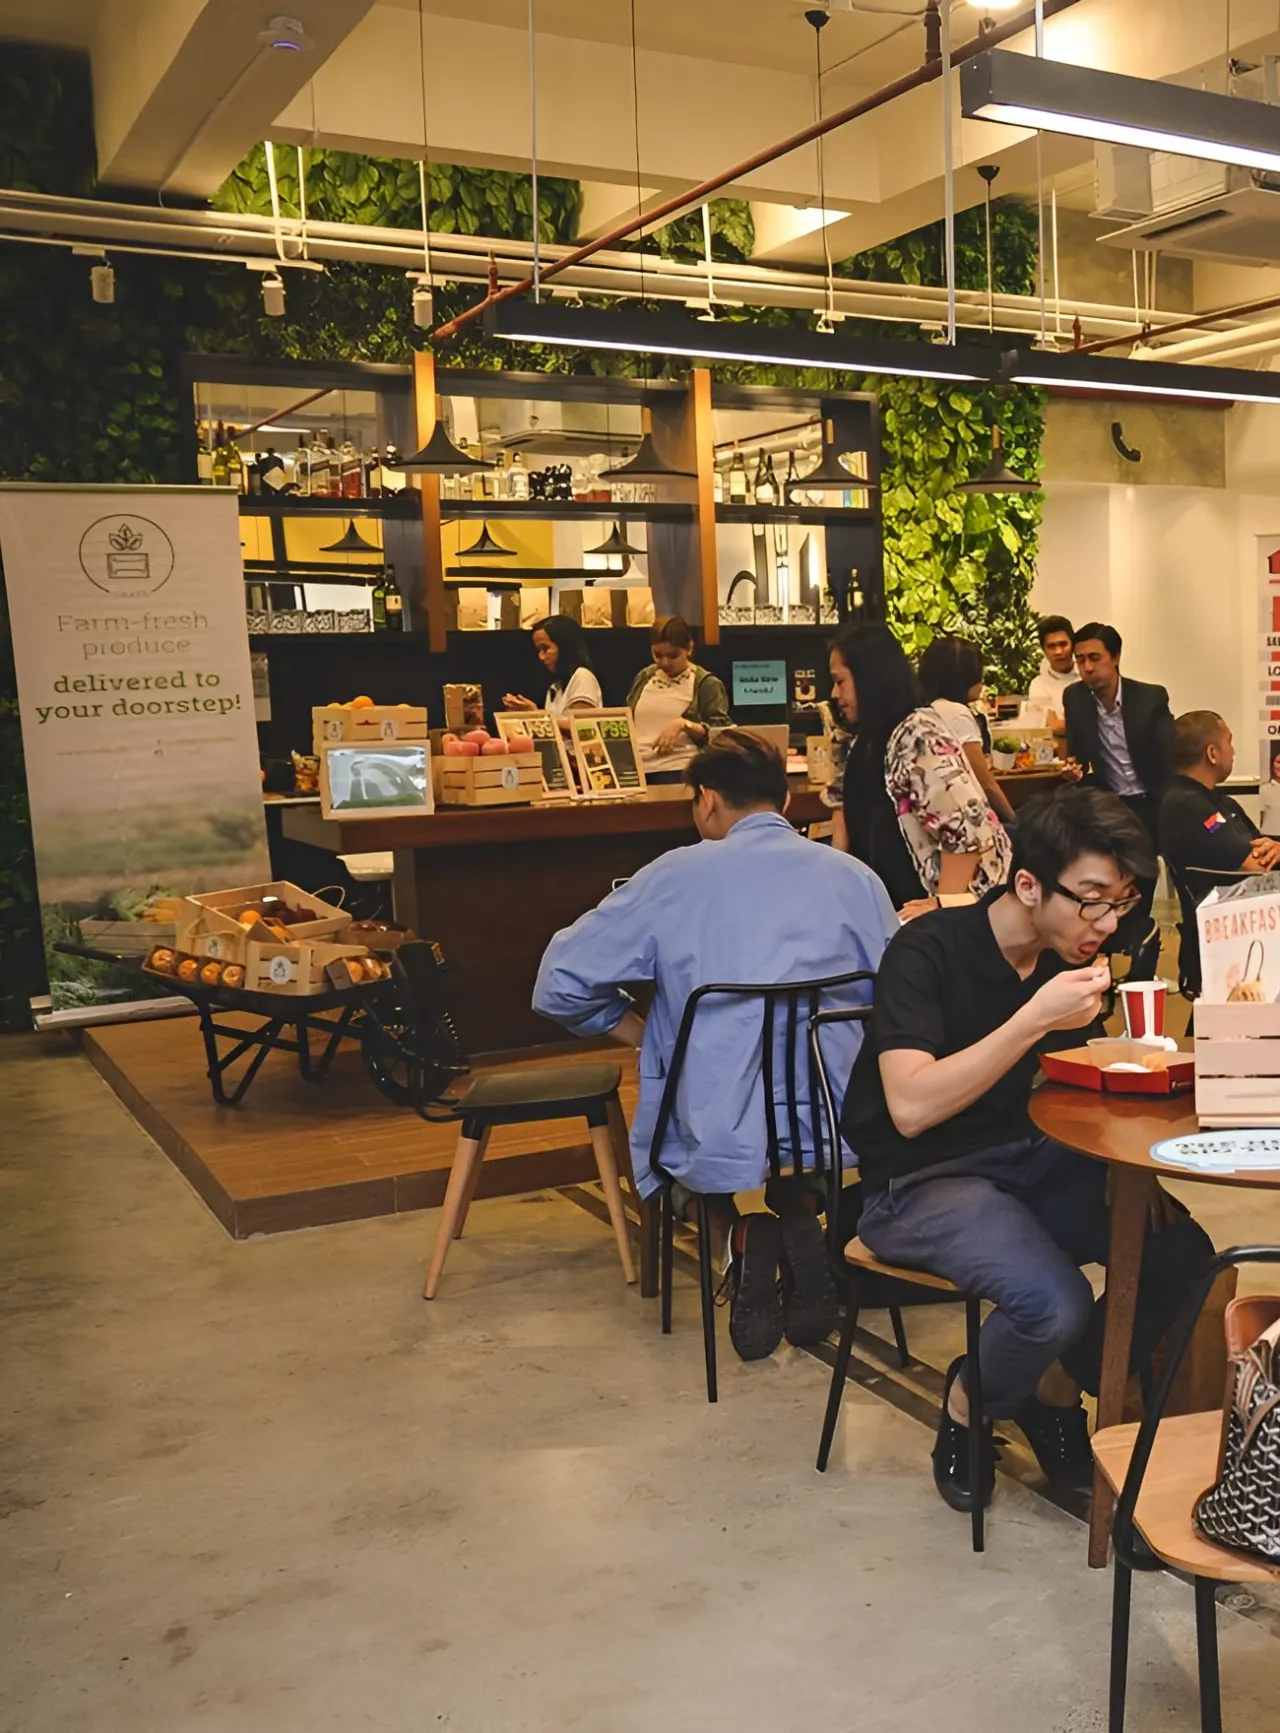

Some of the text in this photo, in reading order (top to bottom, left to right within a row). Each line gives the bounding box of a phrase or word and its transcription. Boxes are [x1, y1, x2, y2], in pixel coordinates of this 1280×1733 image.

[57, 611, 208, 632] Farm-fresh
[83, 636, 191, 659] produce
[54, 671, 220, 694] delivered to
[35, 694, 241, 724] your doorstep!
